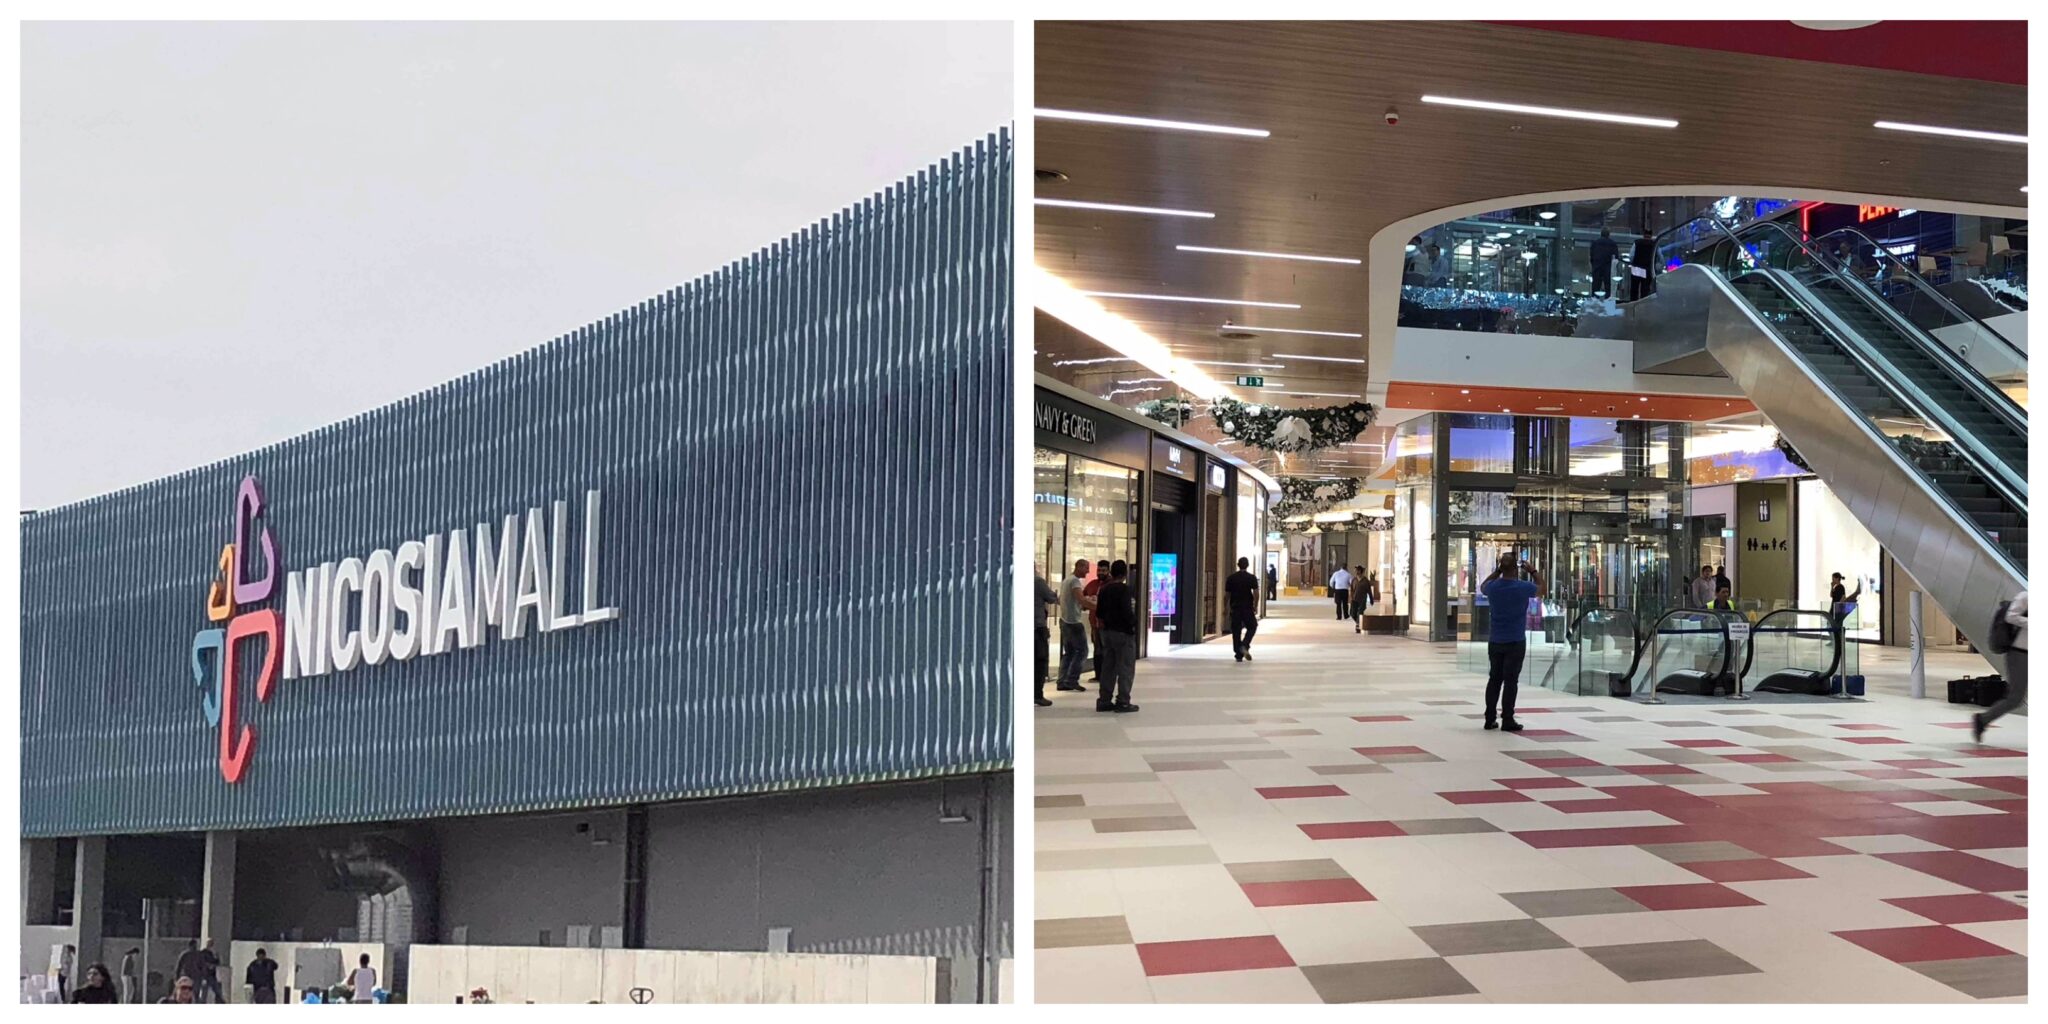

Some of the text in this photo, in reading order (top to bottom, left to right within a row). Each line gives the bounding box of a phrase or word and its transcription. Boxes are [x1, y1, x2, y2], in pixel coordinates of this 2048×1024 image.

[1035, 401, 1097, 444] NAVY & GREEN
